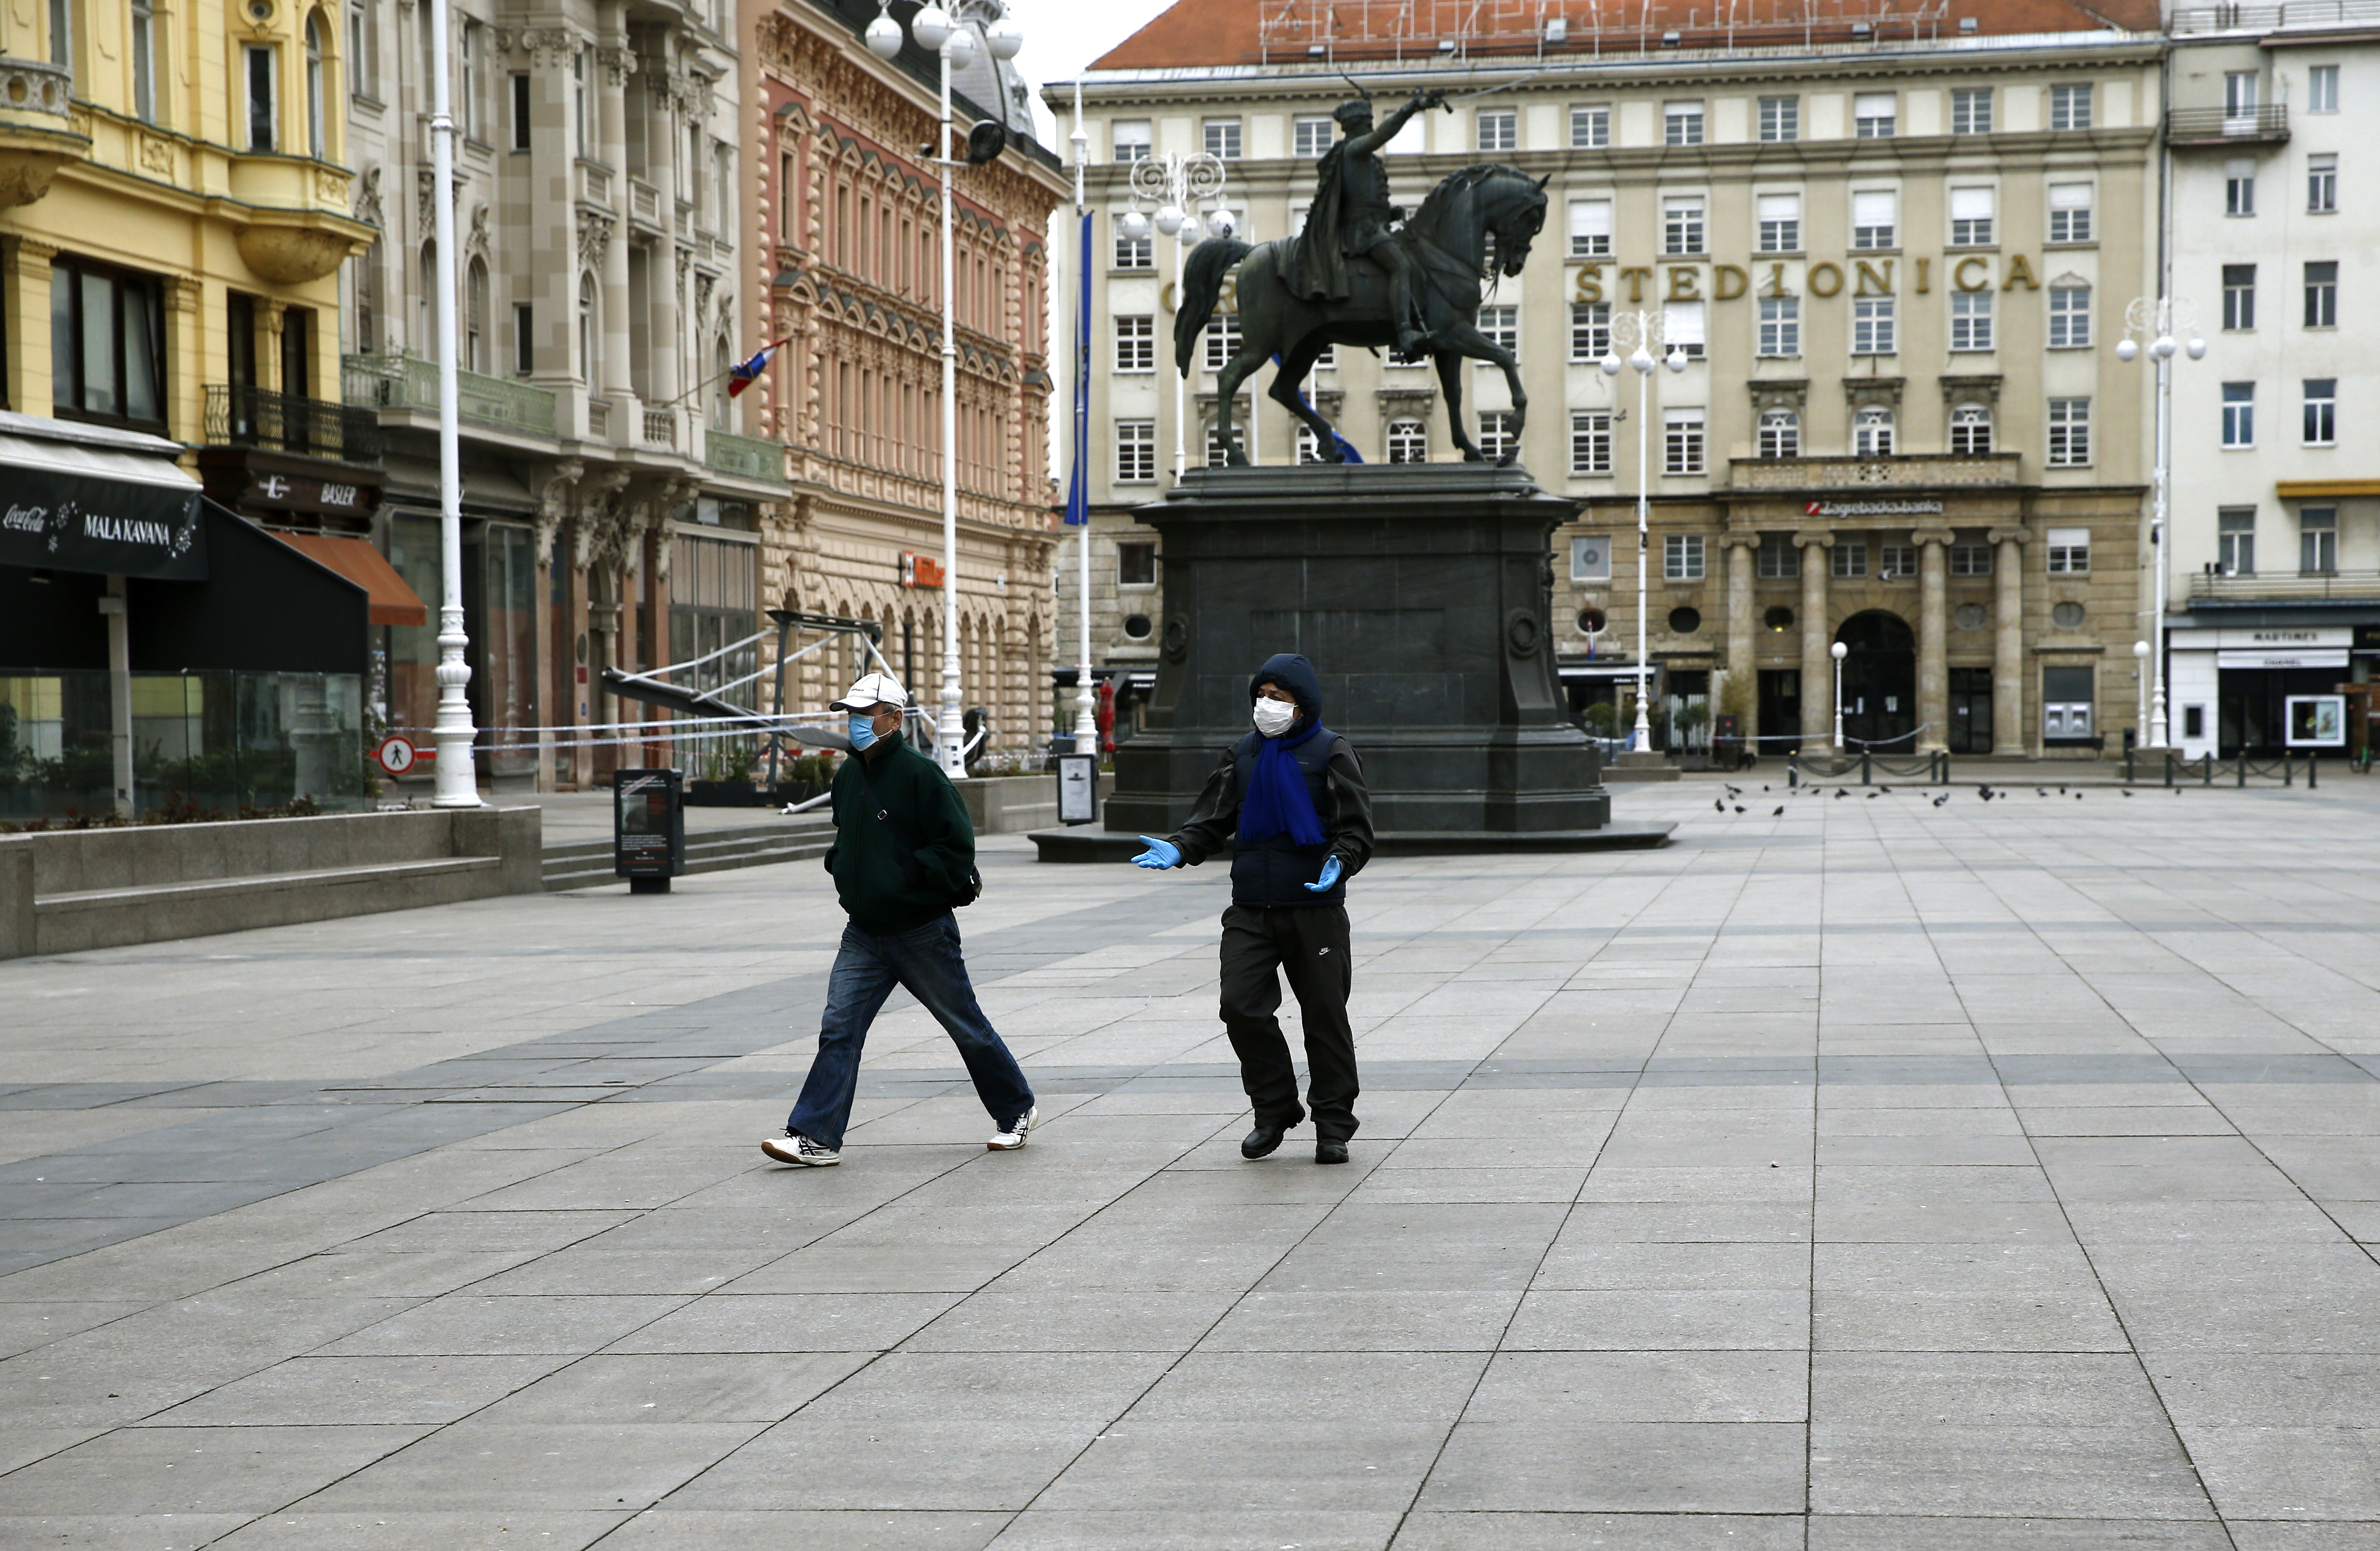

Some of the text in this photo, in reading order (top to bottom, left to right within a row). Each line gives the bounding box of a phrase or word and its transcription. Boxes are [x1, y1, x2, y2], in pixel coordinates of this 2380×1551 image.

[1575, 254, 2040, 303] ŠTEDIONICA
[321, 483, 356, 506] BASLER
[1819, 500, 1943, 518] Zagrebačka banka
[84, 514, 170, 545] MALA KAVANA
